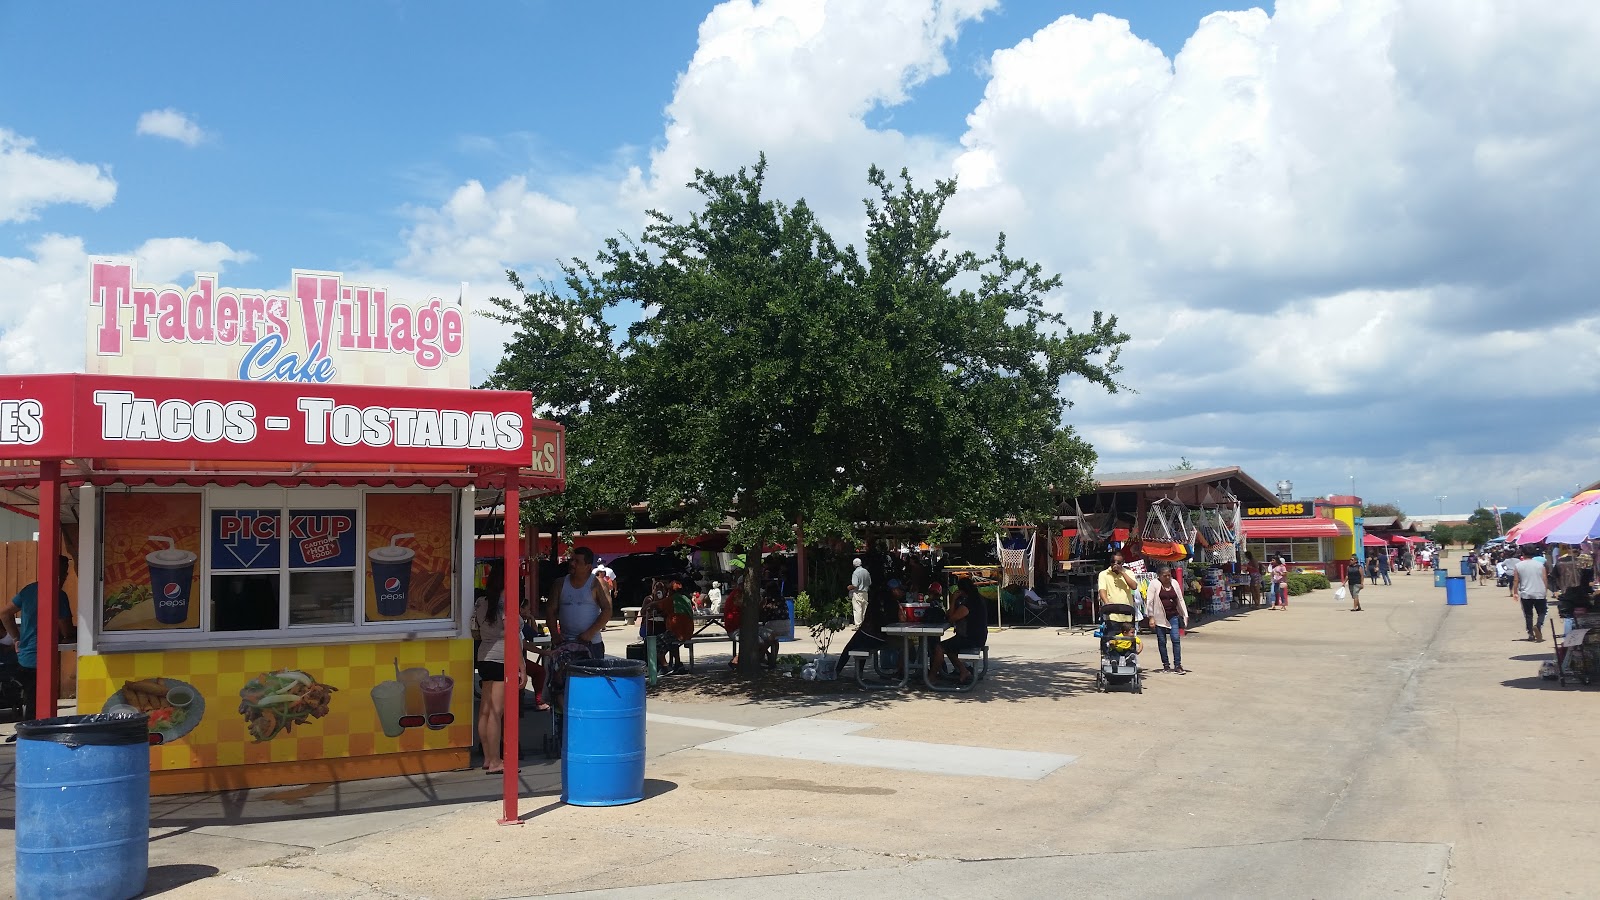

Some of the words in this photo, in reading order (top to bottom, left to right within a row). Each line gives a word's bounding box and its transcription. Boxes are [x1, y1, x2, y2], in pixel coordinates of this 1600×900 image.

[91, 262, 290, 355] Traders
[296, 275, 464, 369] Village
[239, 334, 336, 383] Cafe
[0, 399, 43, 445] ES
[94, 390, 257, 442] TACOS
[297, 398, 524, 450] TOSTADAS
[1247, 503, 1304, 516] BURGERS
[220, 515, 352, 540] PICKUP
[310, 543, 330, 554] HOT
[312, 550, 333, 559] FOOD!
[159, 599, 185, 608] pepsi
[381, 592, 405, 602] pepsi
